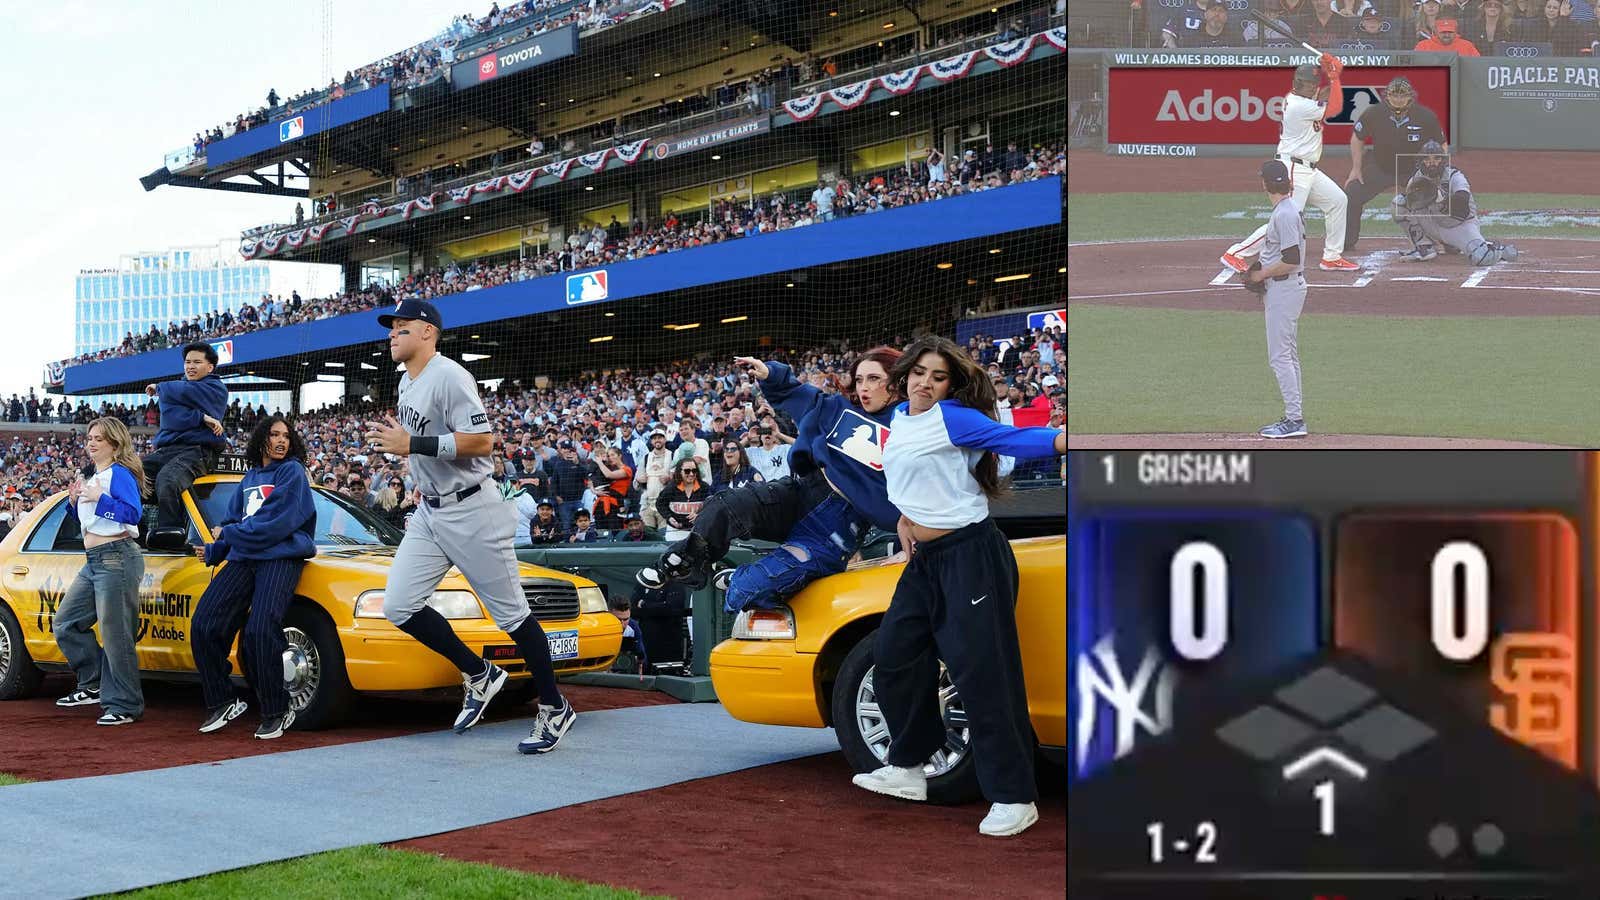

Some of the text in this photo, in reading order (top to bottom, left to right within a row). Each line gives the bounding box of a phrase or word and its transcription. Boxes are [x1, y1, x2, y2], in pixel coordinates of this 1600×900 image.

[500, 45, 543, 68] TOYOTA
[1115, 54, 1149, 65] WILLY
[1152, 54, 1200, 65] ADAMES
[1203, 54, 1280, 66] BOBBLEHEAD
[1289, 55, 1321, 65] MARC
[1350, 55, 1365, 66] VS
[1367, 55, 1391, 66] NYY
[1487, 66, 1600, 89] ORACLE PAR
[1155, 88, 1285, 122] Adobe
[677, 122, 759, 151] HOME OF THE GIANTS
[1118, 144, 1196, 156] NUVEEN.COM
[154, 592, 192, 618] NIGHT
[151, 625, 185, 641] Adobe
